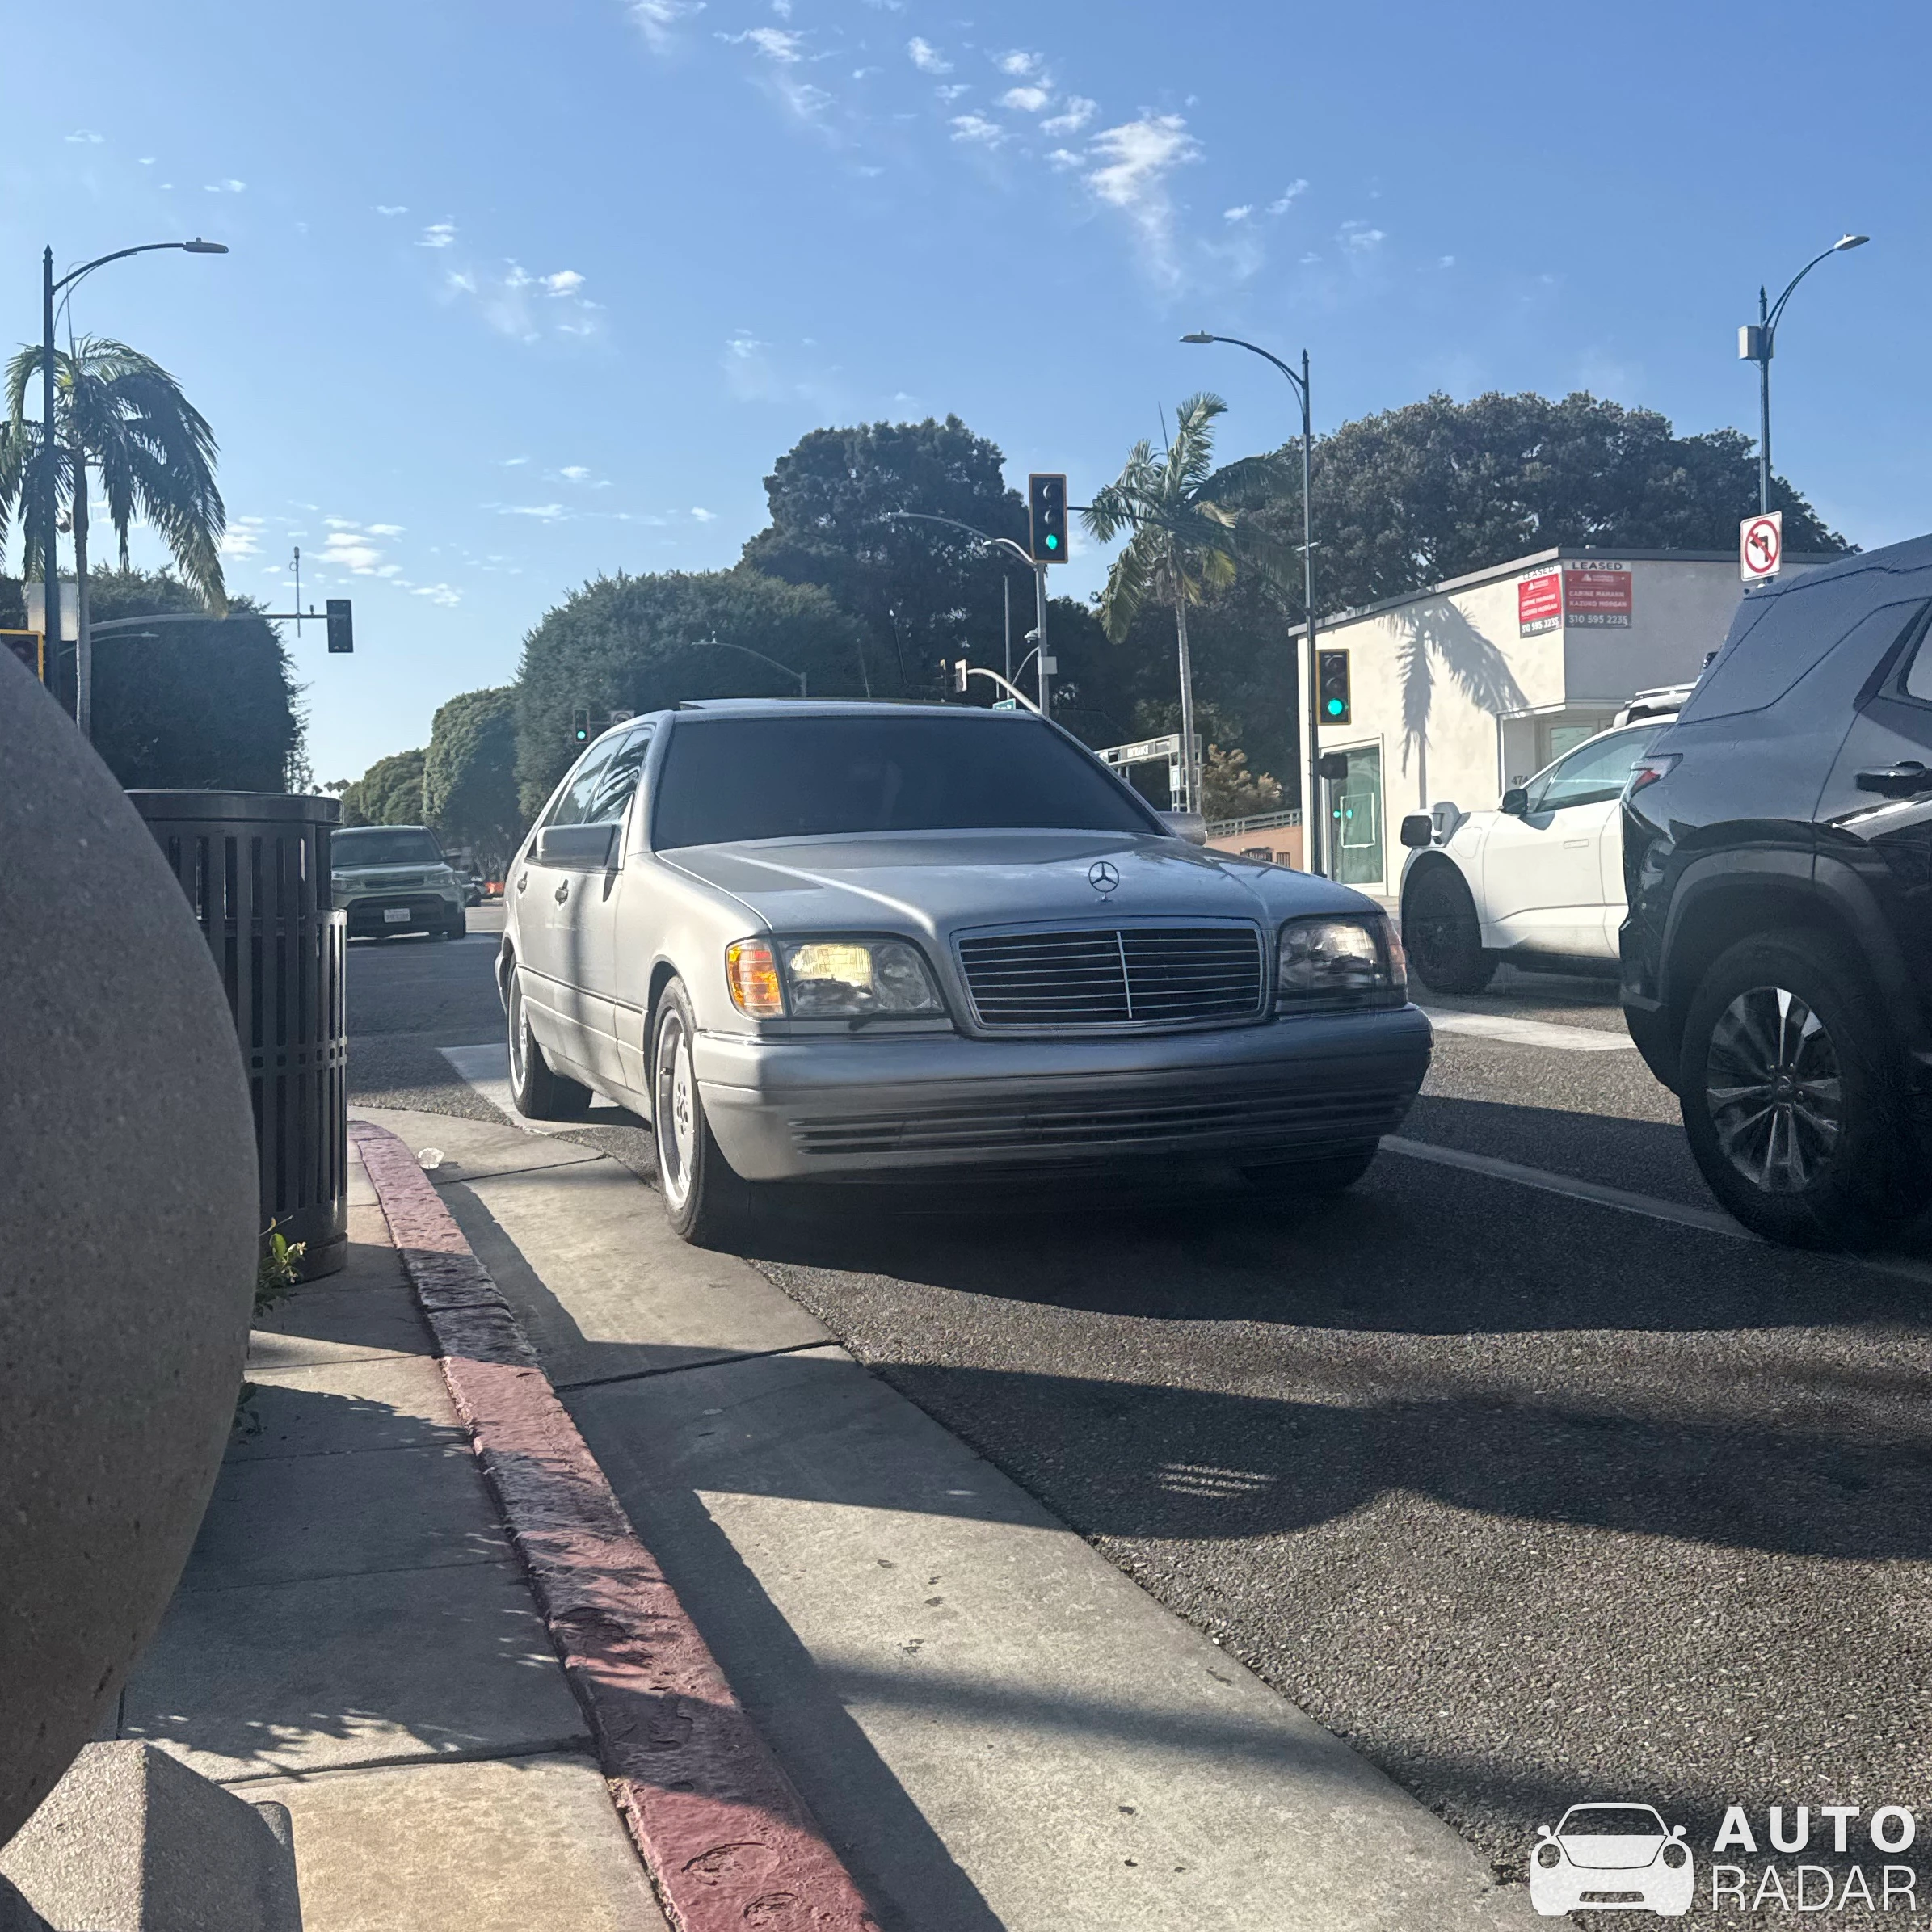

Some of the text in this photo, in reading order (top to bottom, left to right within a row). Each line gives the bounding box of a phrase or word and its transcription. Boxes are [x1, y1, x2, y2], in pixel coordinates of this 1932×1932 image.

[1568, 614, 1627, 625] 310 595 2235
